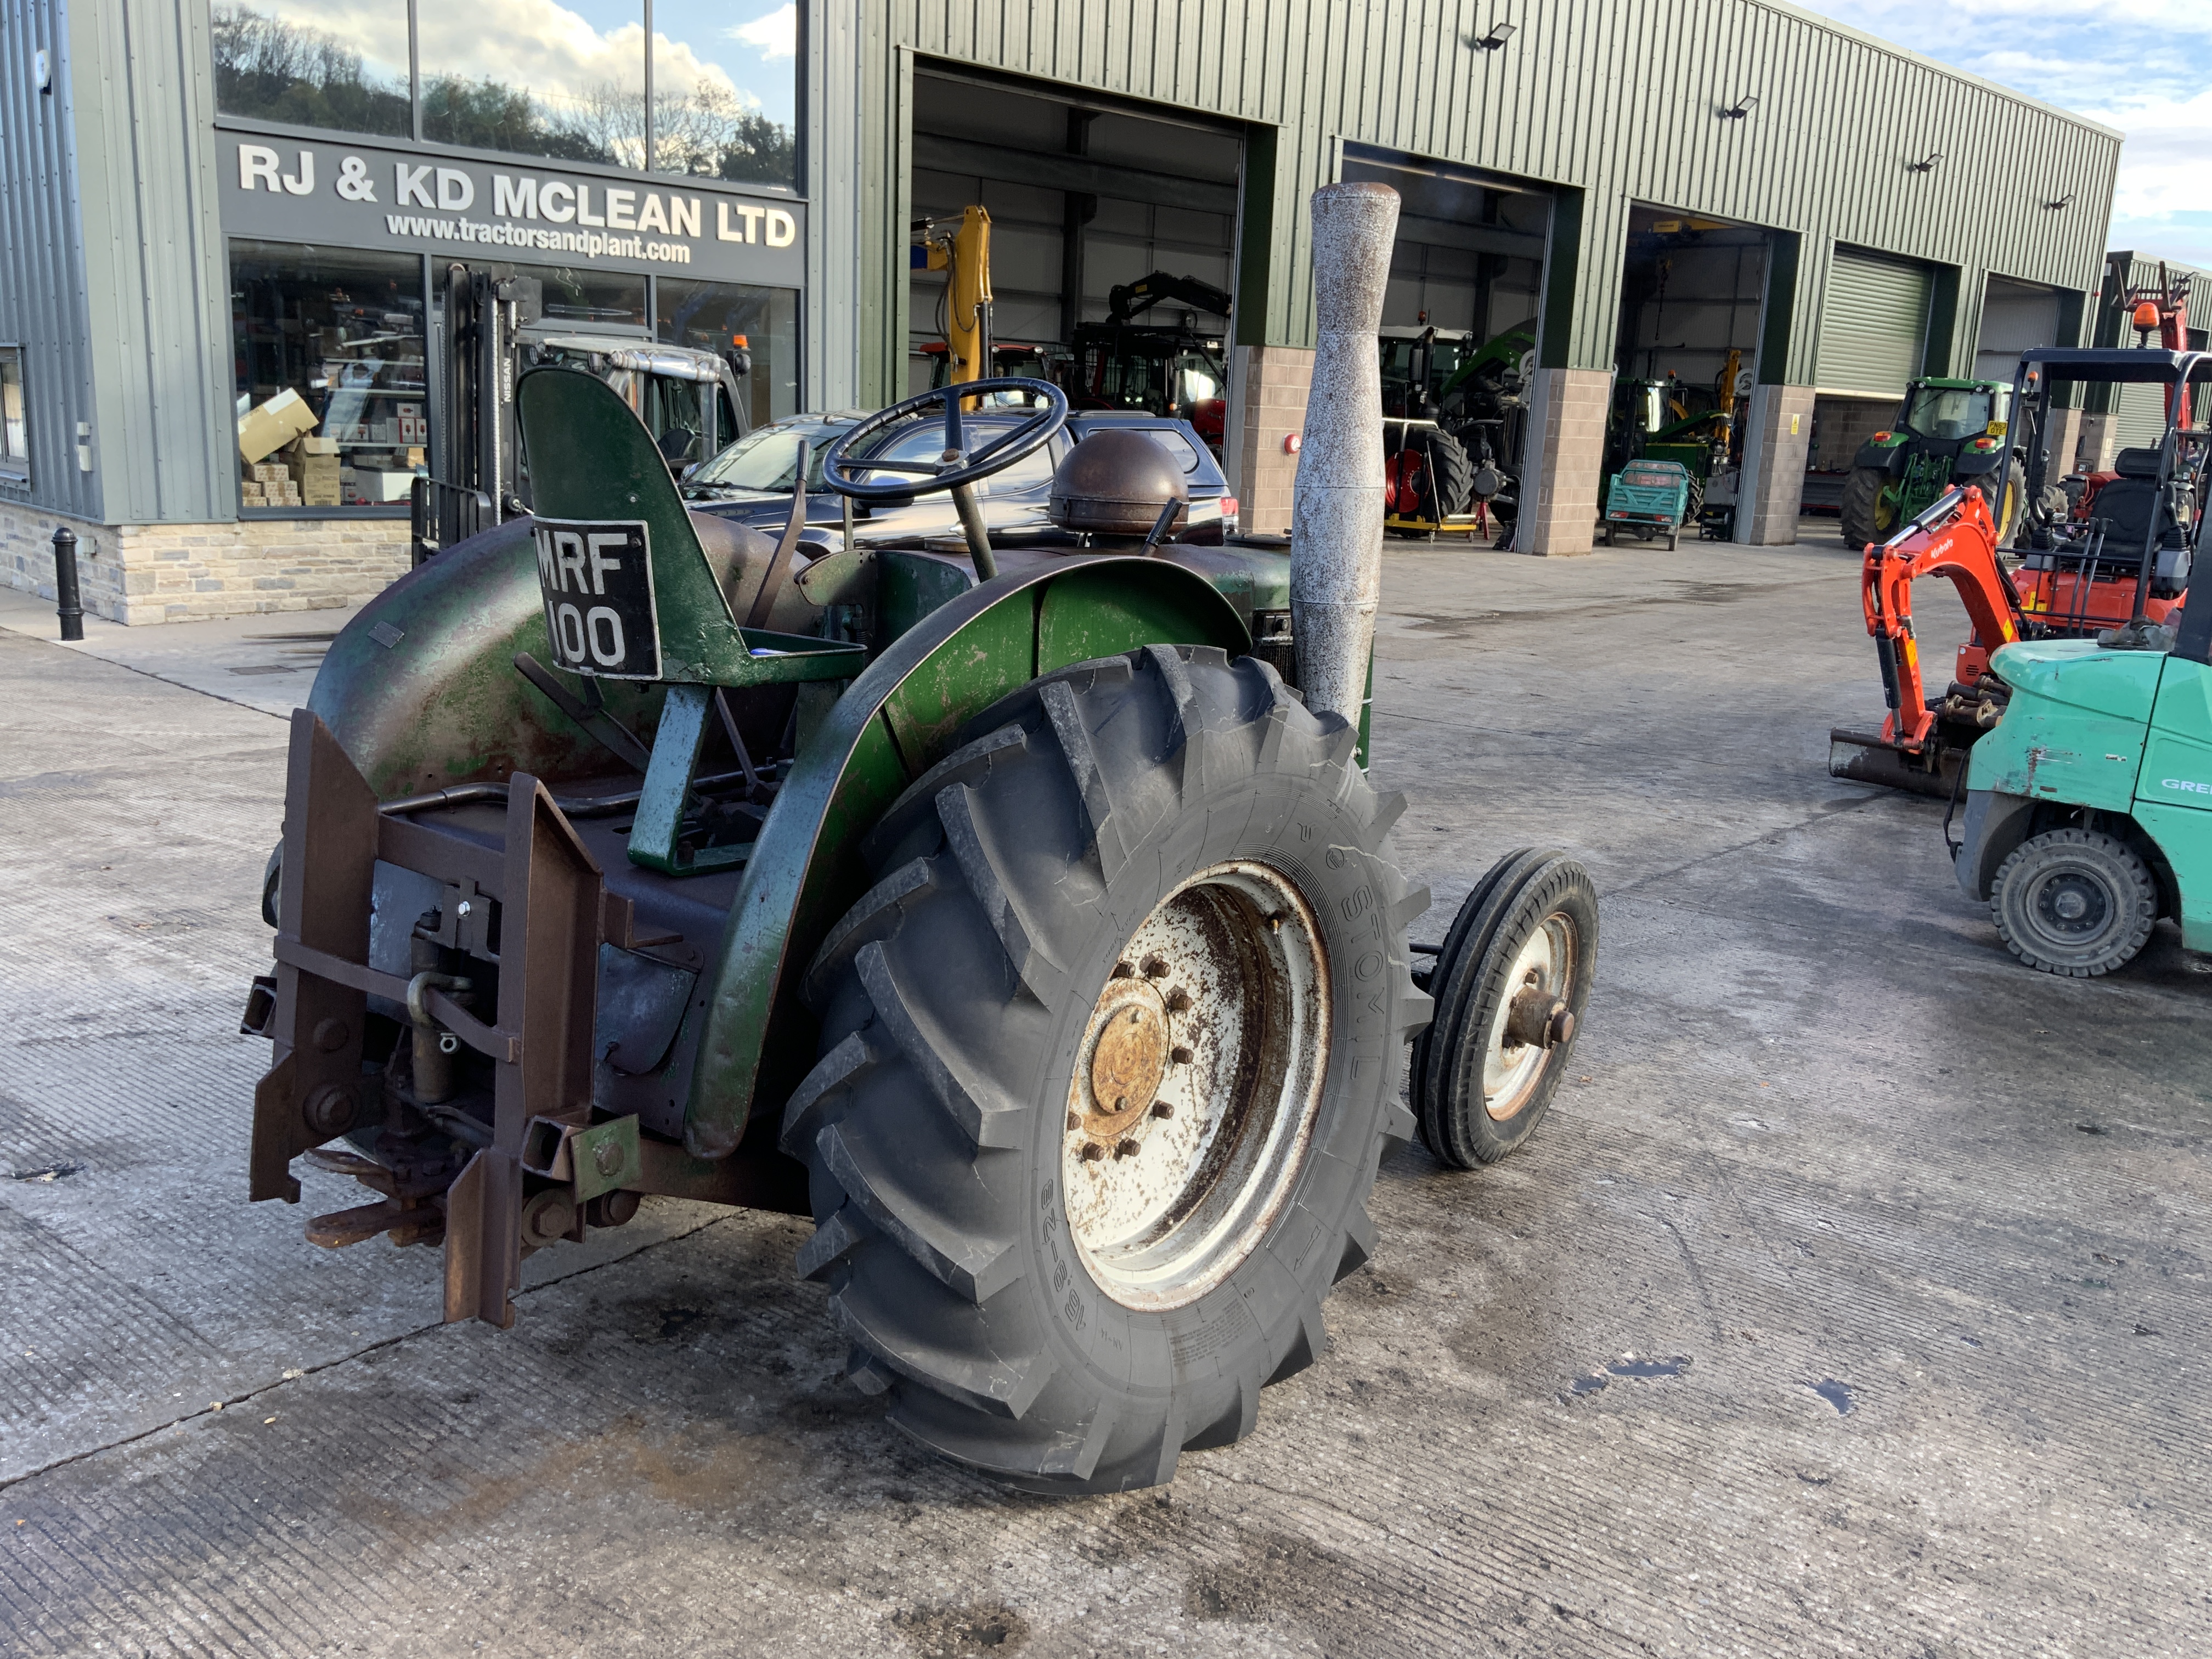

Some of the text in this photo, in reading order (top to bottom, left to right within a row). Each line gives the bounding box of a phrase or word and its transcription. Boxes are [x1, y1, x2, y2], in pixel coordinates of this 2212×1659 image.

[239, 144, 796, 248] RJ & KD MCLEAN LTD
[386, 215, 690, 264] www.tractorsandplant.com
[534, 527, 628, 595] MRF
[1931, 538, 1954, 560] Kubota
[2162, 778, 2212, 795] GRE
[1041, 1178, 1086, 1331] 16.9-28
